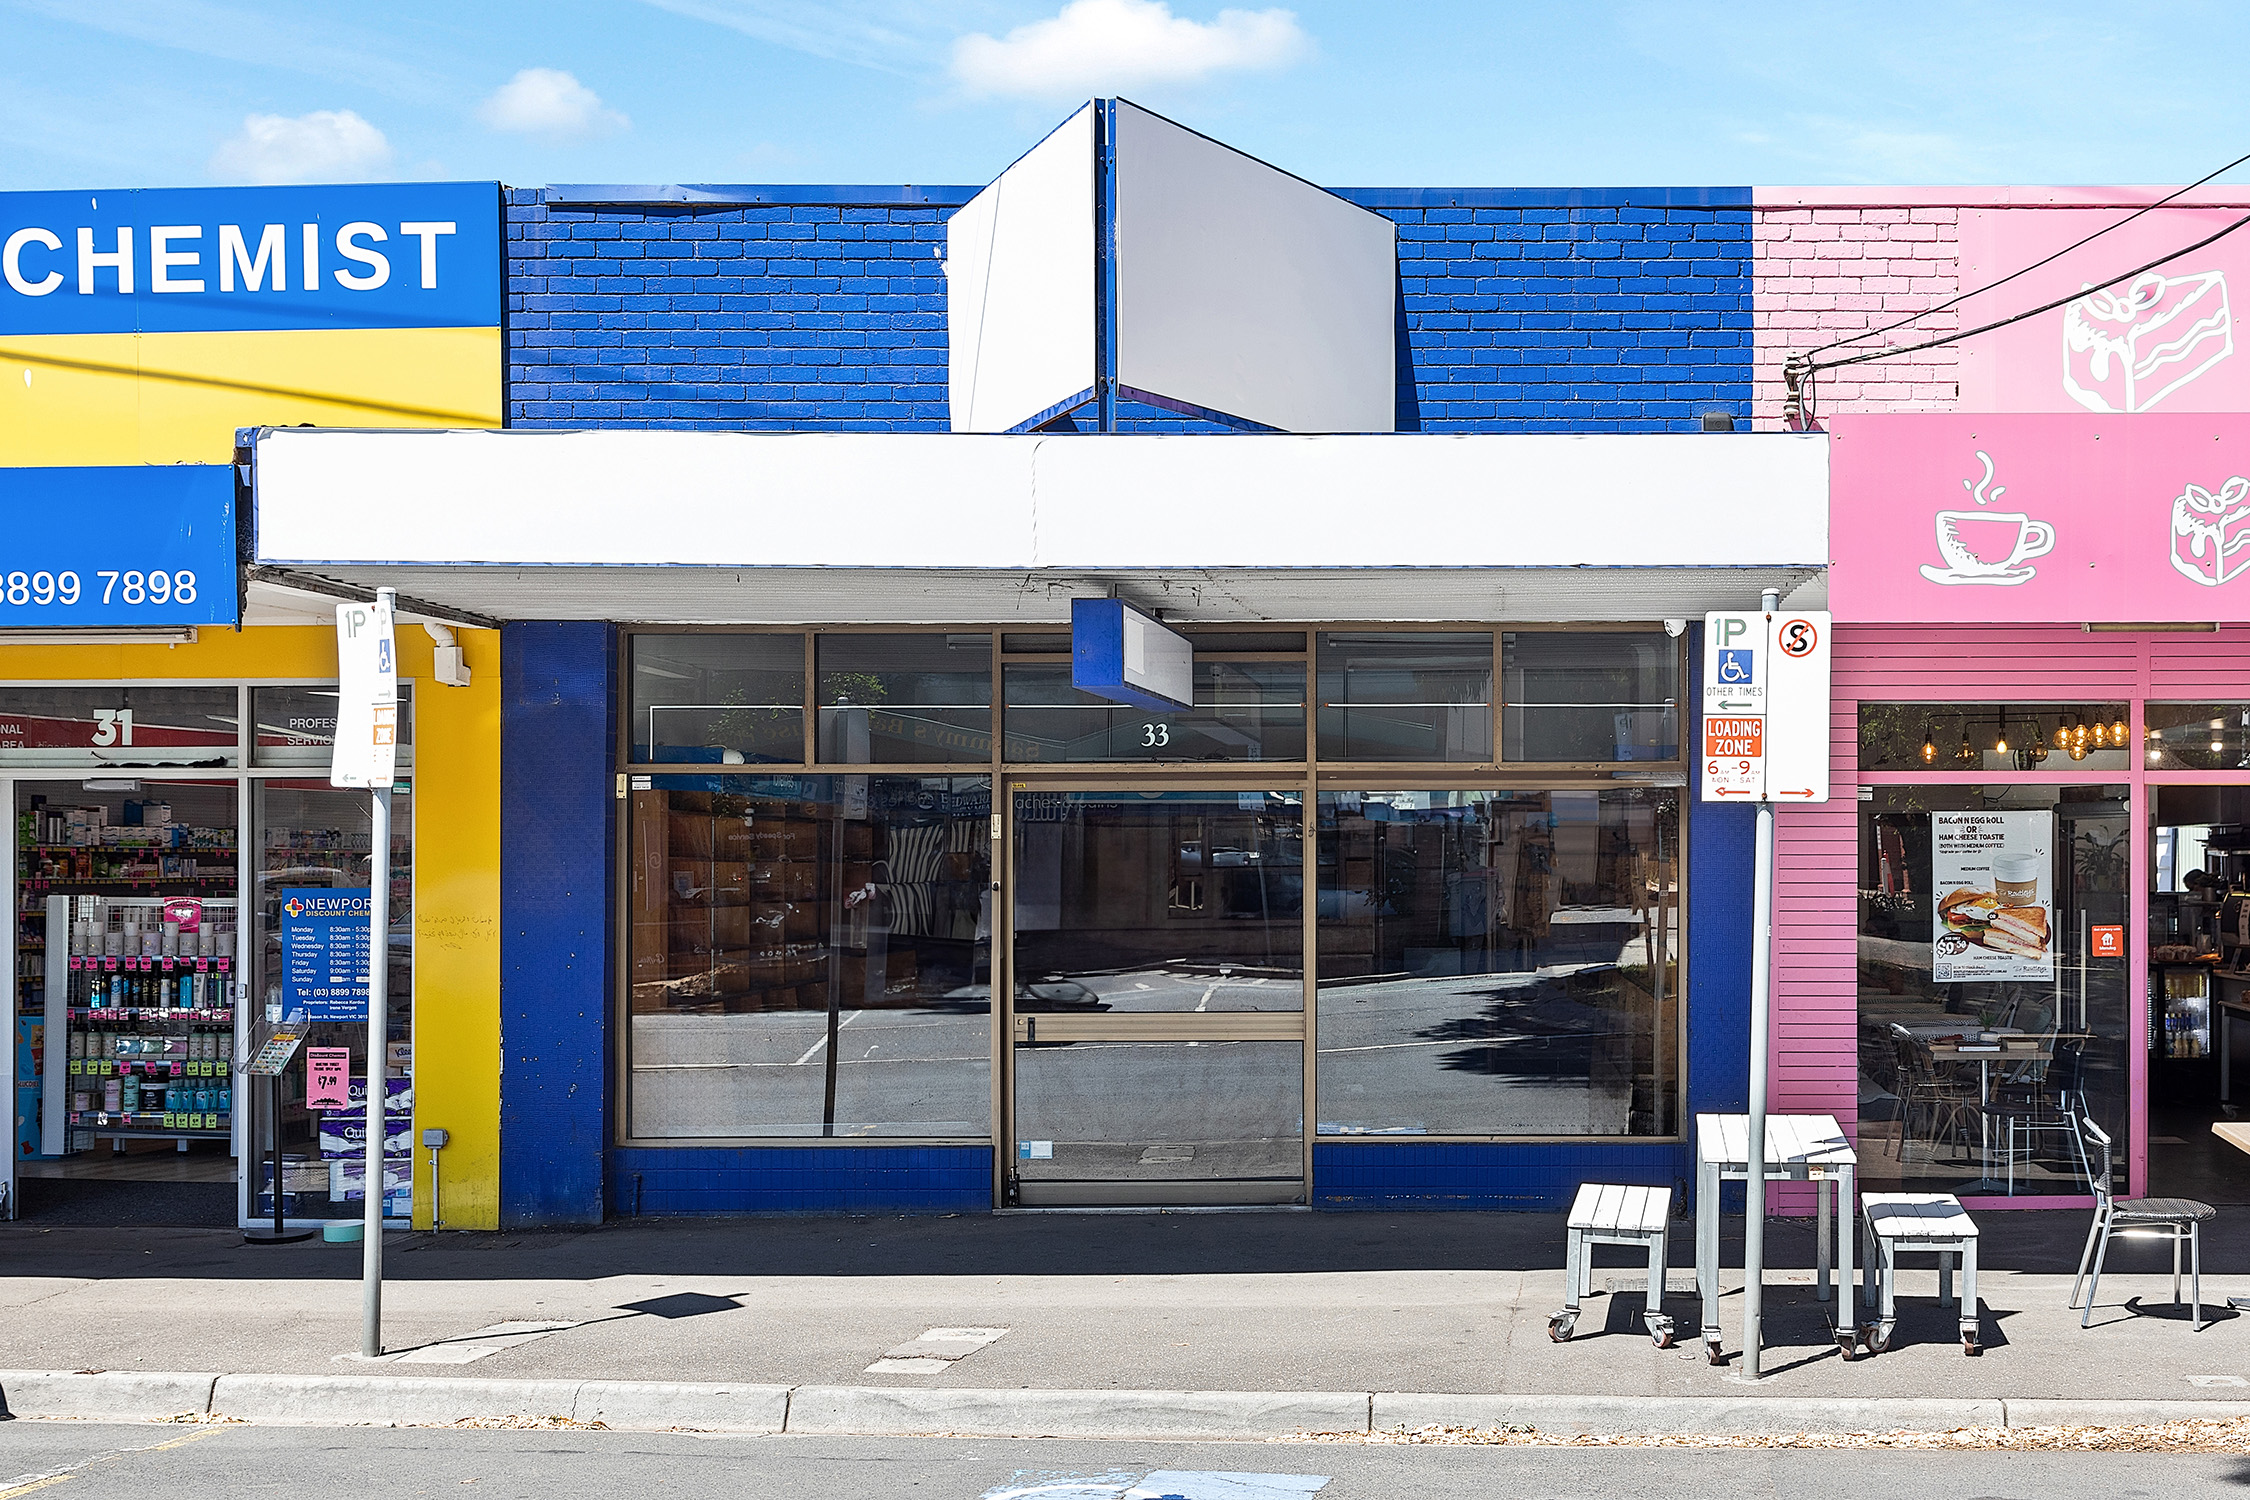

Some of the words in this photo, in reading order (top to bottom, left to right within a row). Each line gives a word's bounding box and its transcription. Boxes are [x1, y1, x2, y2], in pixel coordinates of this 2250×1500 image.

[2, 221, 457, 296] CHEMIST
[96, 569, 198, 605] 7898
[345, 610, 366, 638] 1P
[1713, 618, 1747, 647] 1P
[1706, 686, 1734, 697] OTHER
[1738, 686, 1763, 697] TIMES
[91, 708, 133, 747] 31
[289, 717, 337, 729] PROFES
[1707, 720, 1761, 737] LOADING
[0, 724, 24, 735] NAL
[287, 735, 334, 746] SERVIC
[1140, 723, 1170, 748] 33
[0, 740, 25, 749] REA
[1714, 739, 1754, 756] ZONE
[1938, 816, 1963, 825] BACON
[1963, 816, 1970, 824] N
[1971, 816, 1986, 824] EGG
[1986, 816, 2005, 824] ROLL
[1965, 825, 1978, 834] OR
[1938, 833, 1954, 841] HAM
[1954, 833, 1978, 841] CHEESE
[1979, 833, 2005, 841] TOASTIE
[305, 898, 371, 910] NEWPOR
[291, 926, 314, 934] Monday
[291, 934, 316, 942] Tuesday
[291, 943, 324, 951] Wednesday
[291, 951, 318, 959] Thursday
[291, 959, 310, 967] Friday
[291, 976, 313, 984] Sunday
[297, 988, 311, 997] Tel:
[313, 988, 329, 998] (03)
[330, 988, 350, 997] 8899
[351, 988, 369, 997] 7898
[318, 1075, 338, 1090] $7.99
